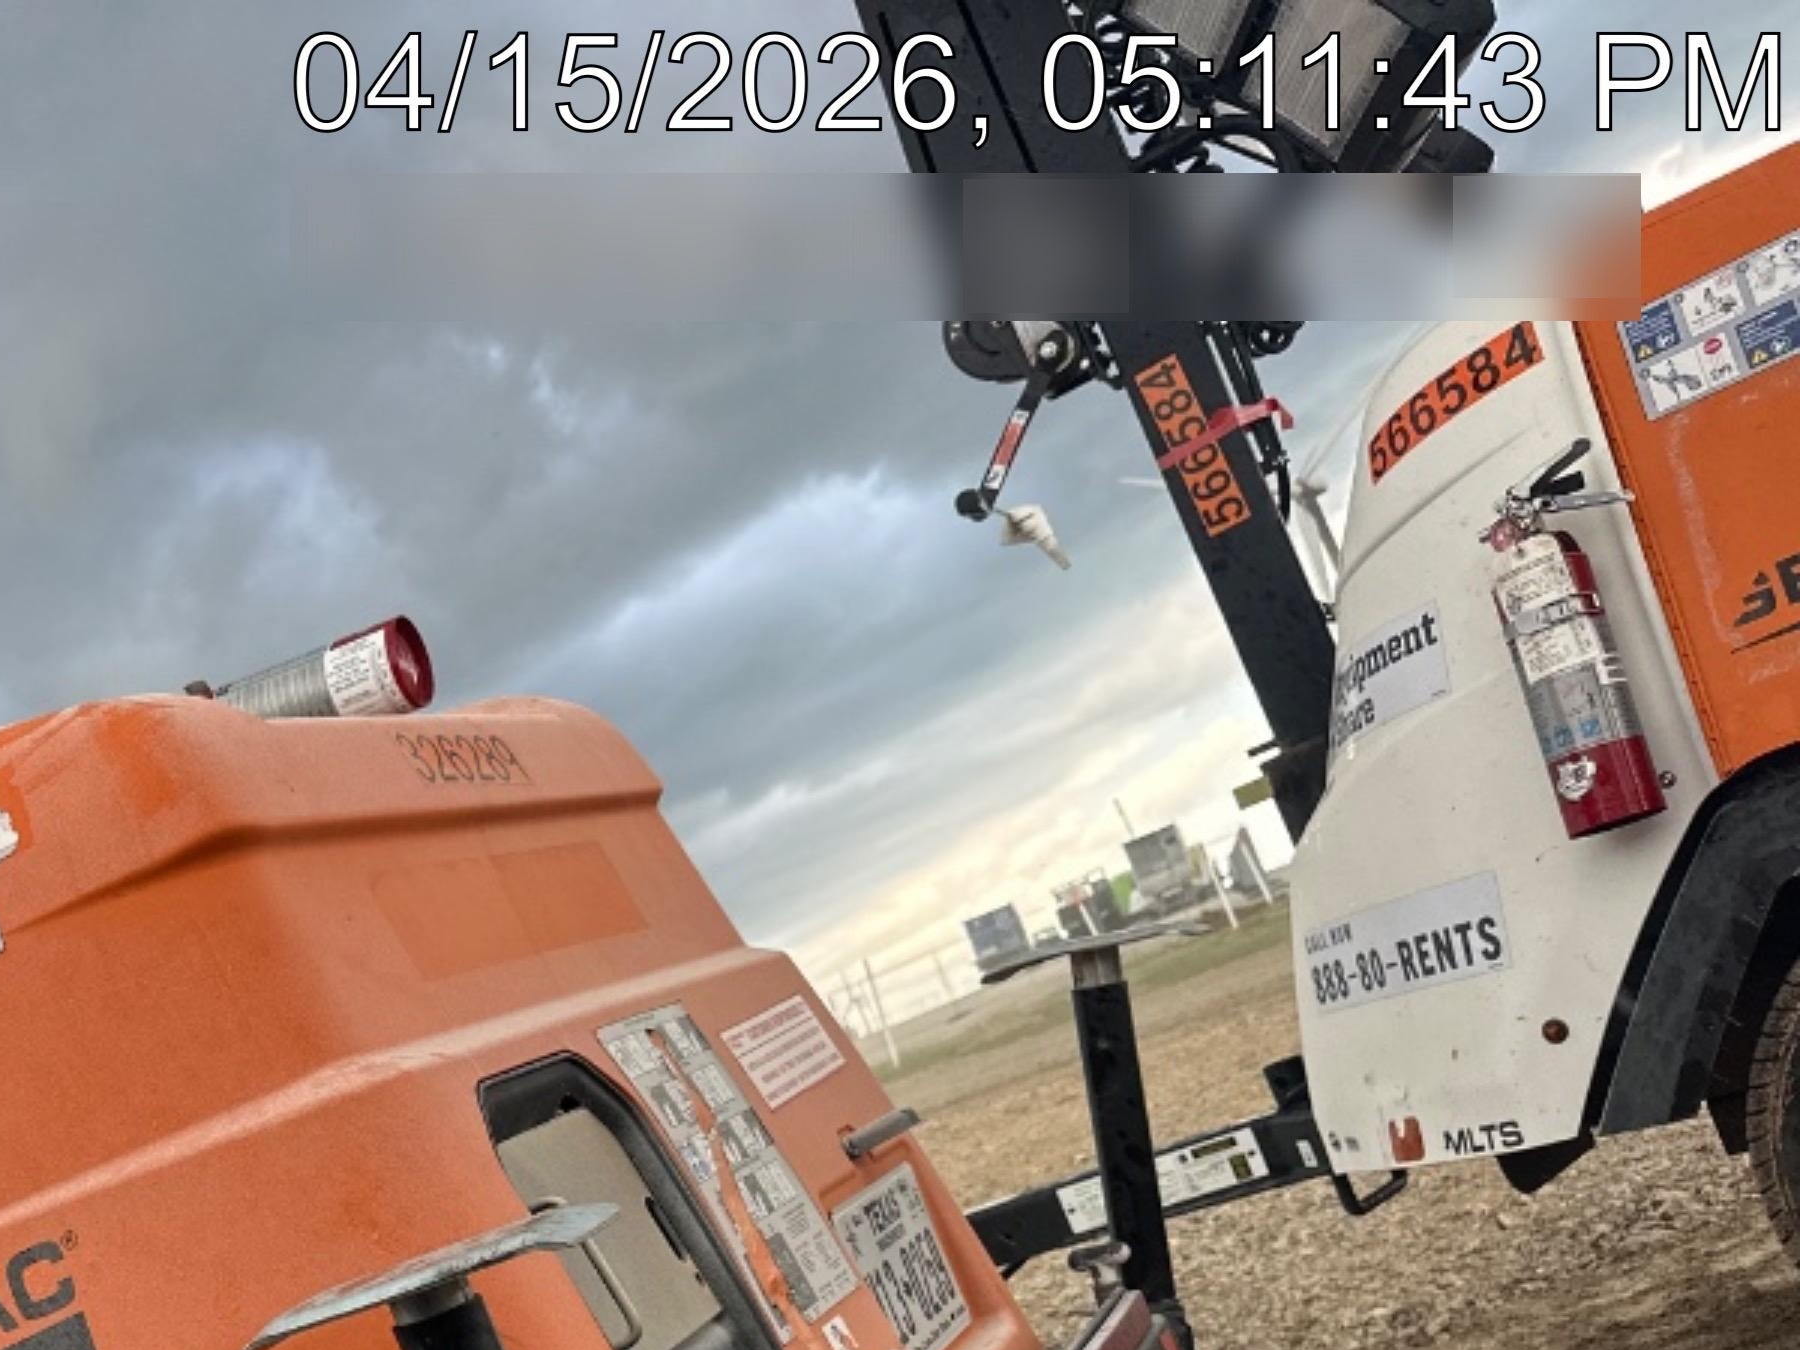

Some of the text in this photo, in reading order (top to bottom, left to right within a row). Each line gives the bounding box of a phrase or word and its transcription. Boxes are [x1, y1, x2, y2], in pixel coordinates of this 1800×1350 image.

[1140, 360, 1243, 528] 566584
[1370, 322, 1538, 477] 566584
[396, 733, 530, 784] 326289
[1312, 915, 1502, 1005] 888-80-RENTS
[1443, 1120, 1524, 1155] MLTS
